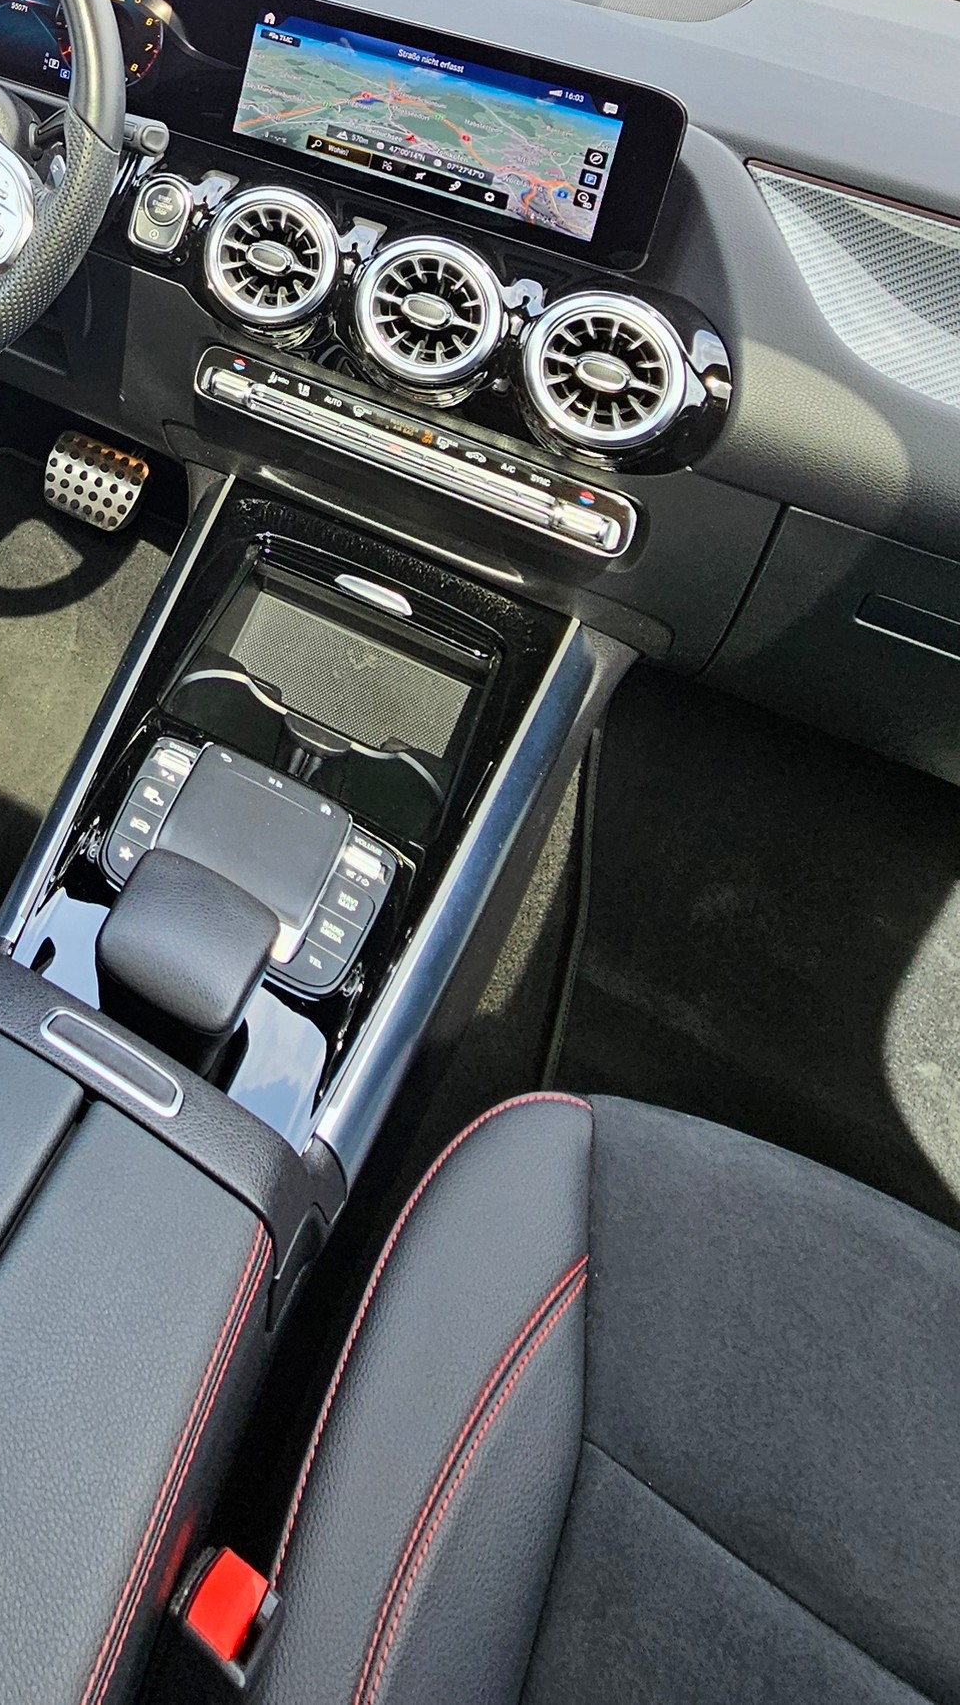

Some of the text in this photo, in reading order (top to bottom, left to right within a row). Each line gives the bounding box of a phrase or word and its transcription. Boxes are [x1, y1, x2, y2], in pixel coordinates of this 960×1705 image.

[145, 17, 154, 26] 6
[279, 35, 294, 44] TMC
[144, 43, 153, 51] 7
[397, 48, 465, 74] Straße nicht erfasst
[130, 63, 139, 72] 8
[564, 91, 584, 103] 16:03
[351, 134, 369, 145] 570m
[328, 143, 350, 156] Wohin?
[324, 395, 342, 408] AUTO
[500, 462, 516, 474] A/C
[530, 473, 552, 487] SYNC
[340, 891, 359, 907] NAVI
[322, 919, 345, 937] RADIO
[309, 955, 323, 970] TEL
